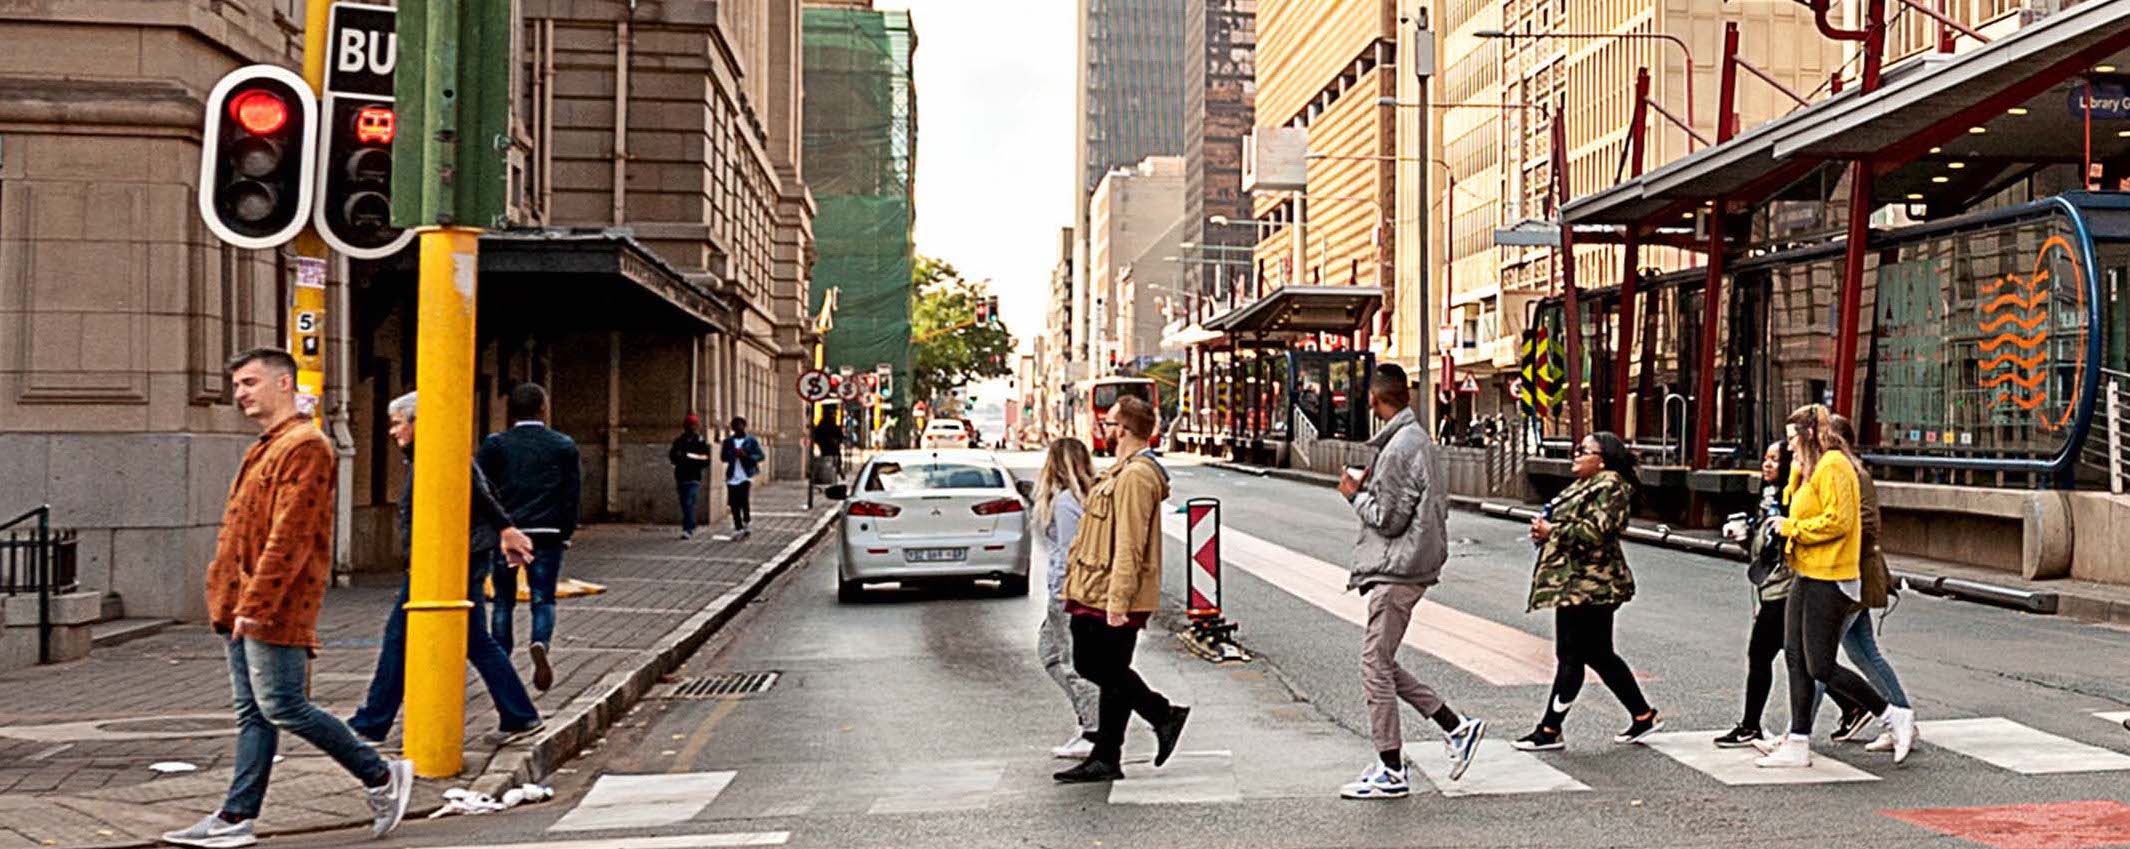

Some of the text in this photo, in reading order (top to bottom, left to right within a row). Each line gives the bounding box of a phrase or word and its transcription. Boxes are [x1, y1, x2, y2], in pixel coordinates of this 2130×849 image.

[338, 27, 398, 75] BU
[2079, 96, 2120, 112] Lbrary
[300, 313, 312, 331] 5
